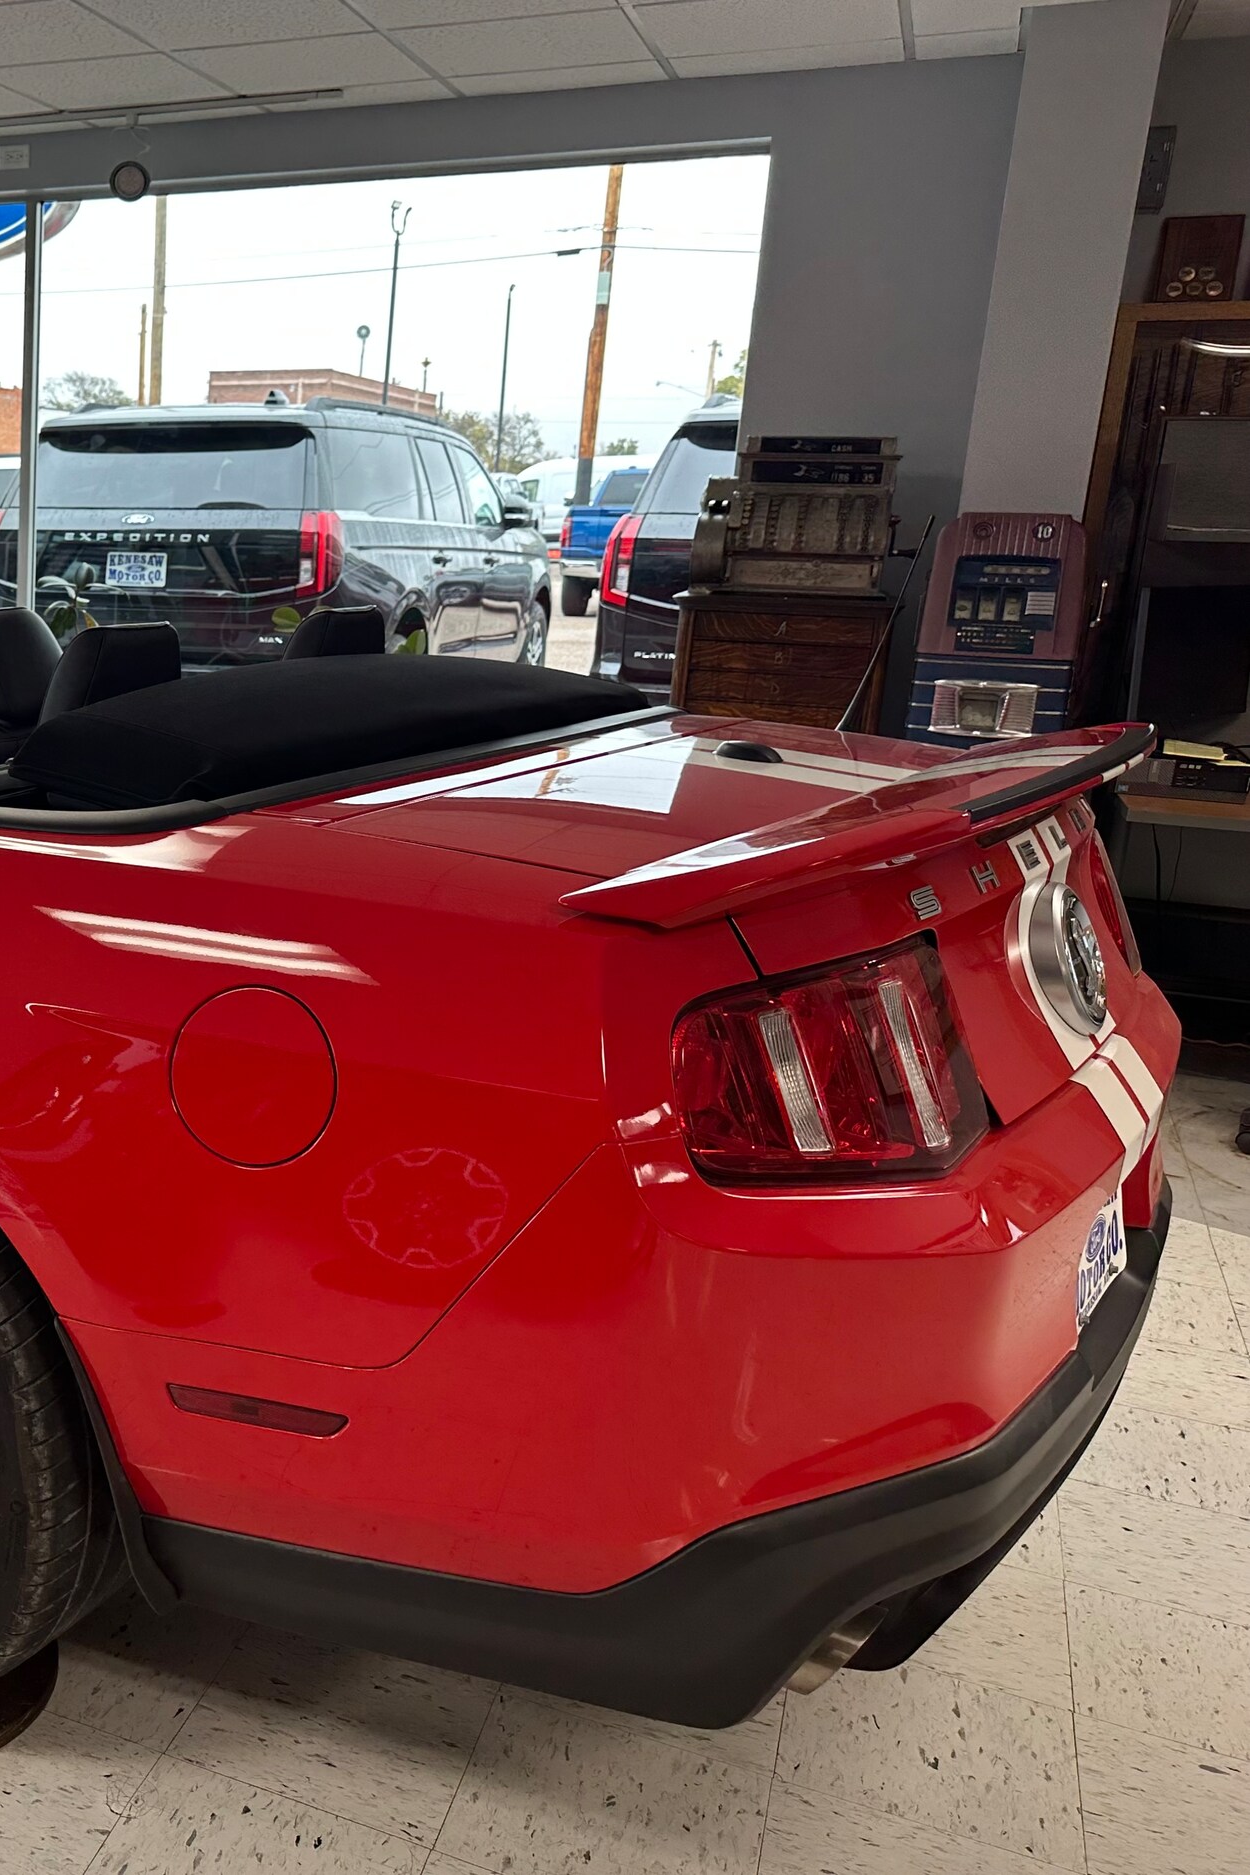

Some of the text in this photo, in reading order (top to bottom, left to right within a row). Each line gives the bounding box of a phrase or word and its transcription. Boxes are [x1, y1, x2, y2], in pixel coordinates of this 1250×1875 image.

[64, 532, 210, 543] EXPEDITION
[1036, 525, 1052, 538] 10
[109, 554, 165, 567] KENESAW
[108, 568, 146, 582] MOTOR
[910, 796, 1092, 920] SHELB
[1076, 1245, 1105, 1316] OTOR
